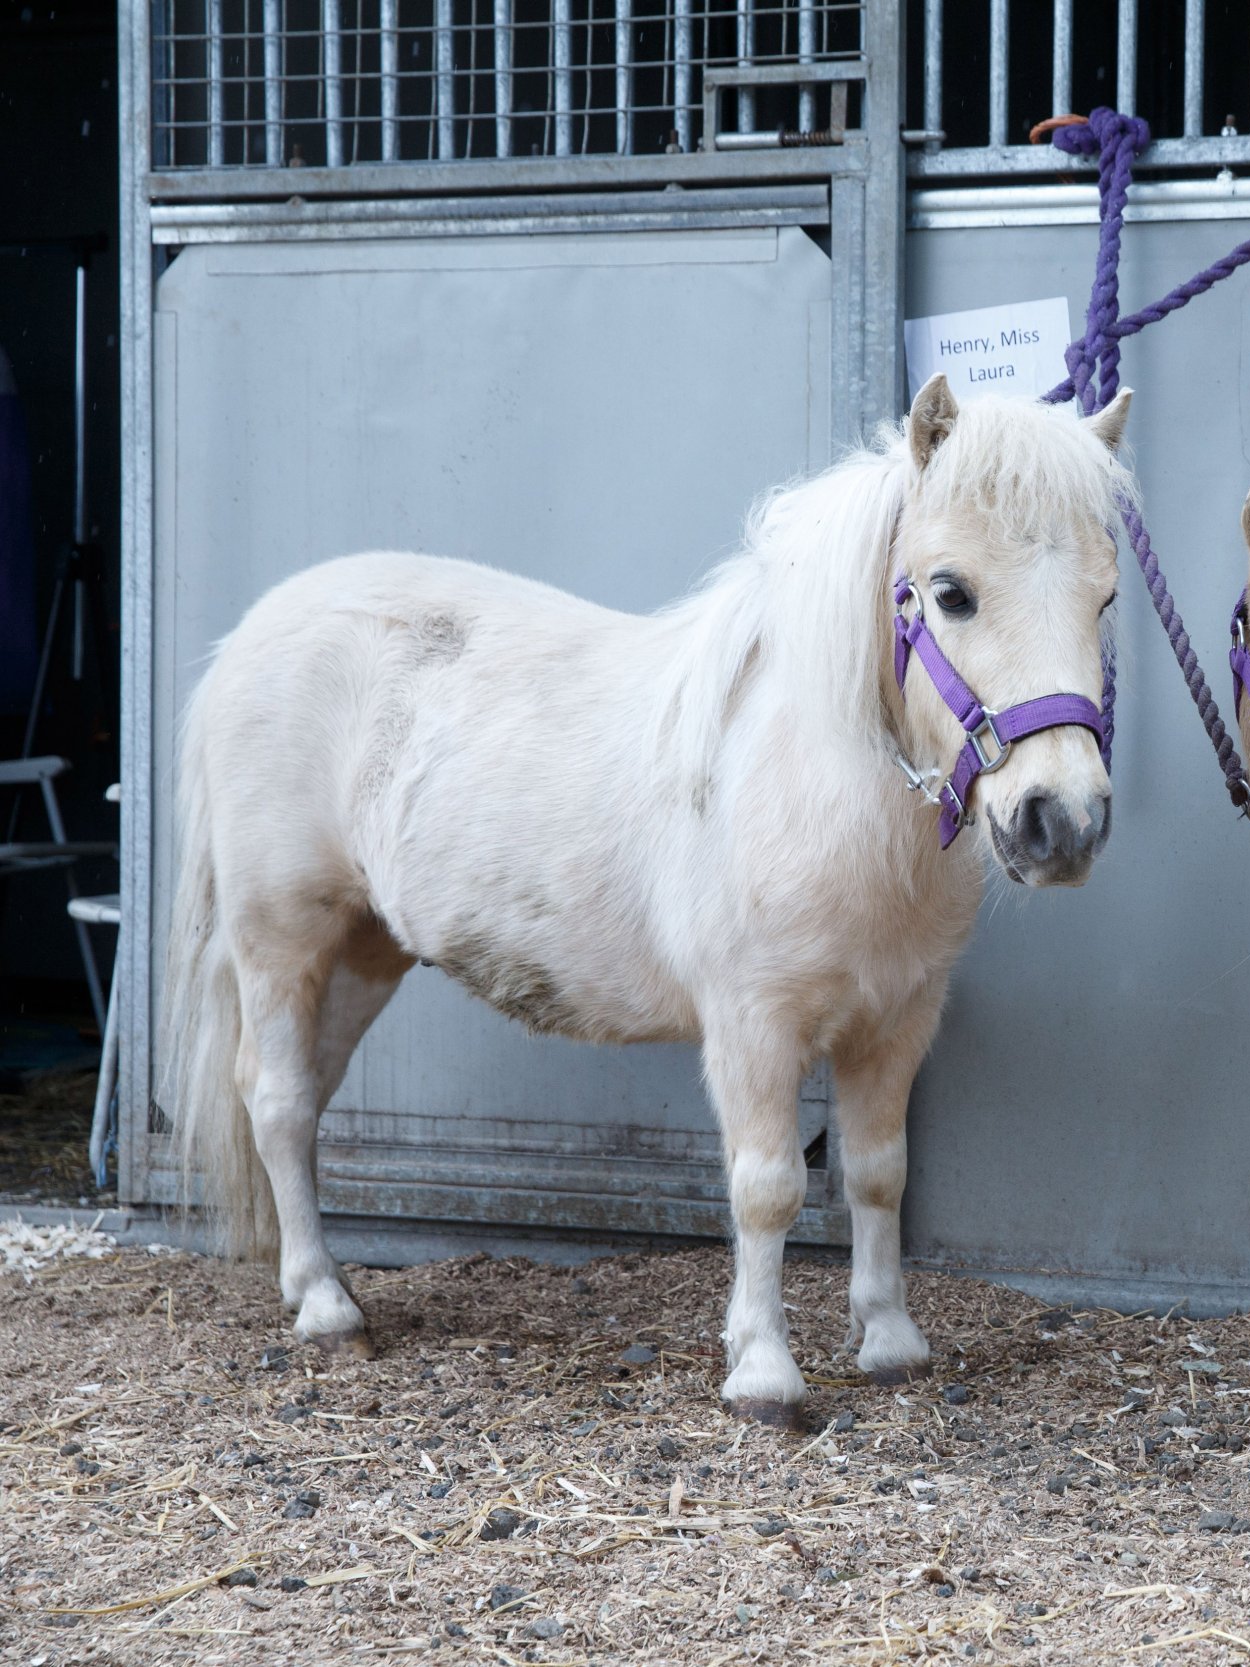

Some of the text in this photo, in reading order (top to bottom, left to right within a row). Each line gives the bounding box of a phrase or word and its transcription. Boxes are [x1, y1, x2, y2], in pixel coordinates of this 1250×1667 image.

[940, 328, 1040, 356] Henry, Miss
[968, 364, 1015, 383] Laura
